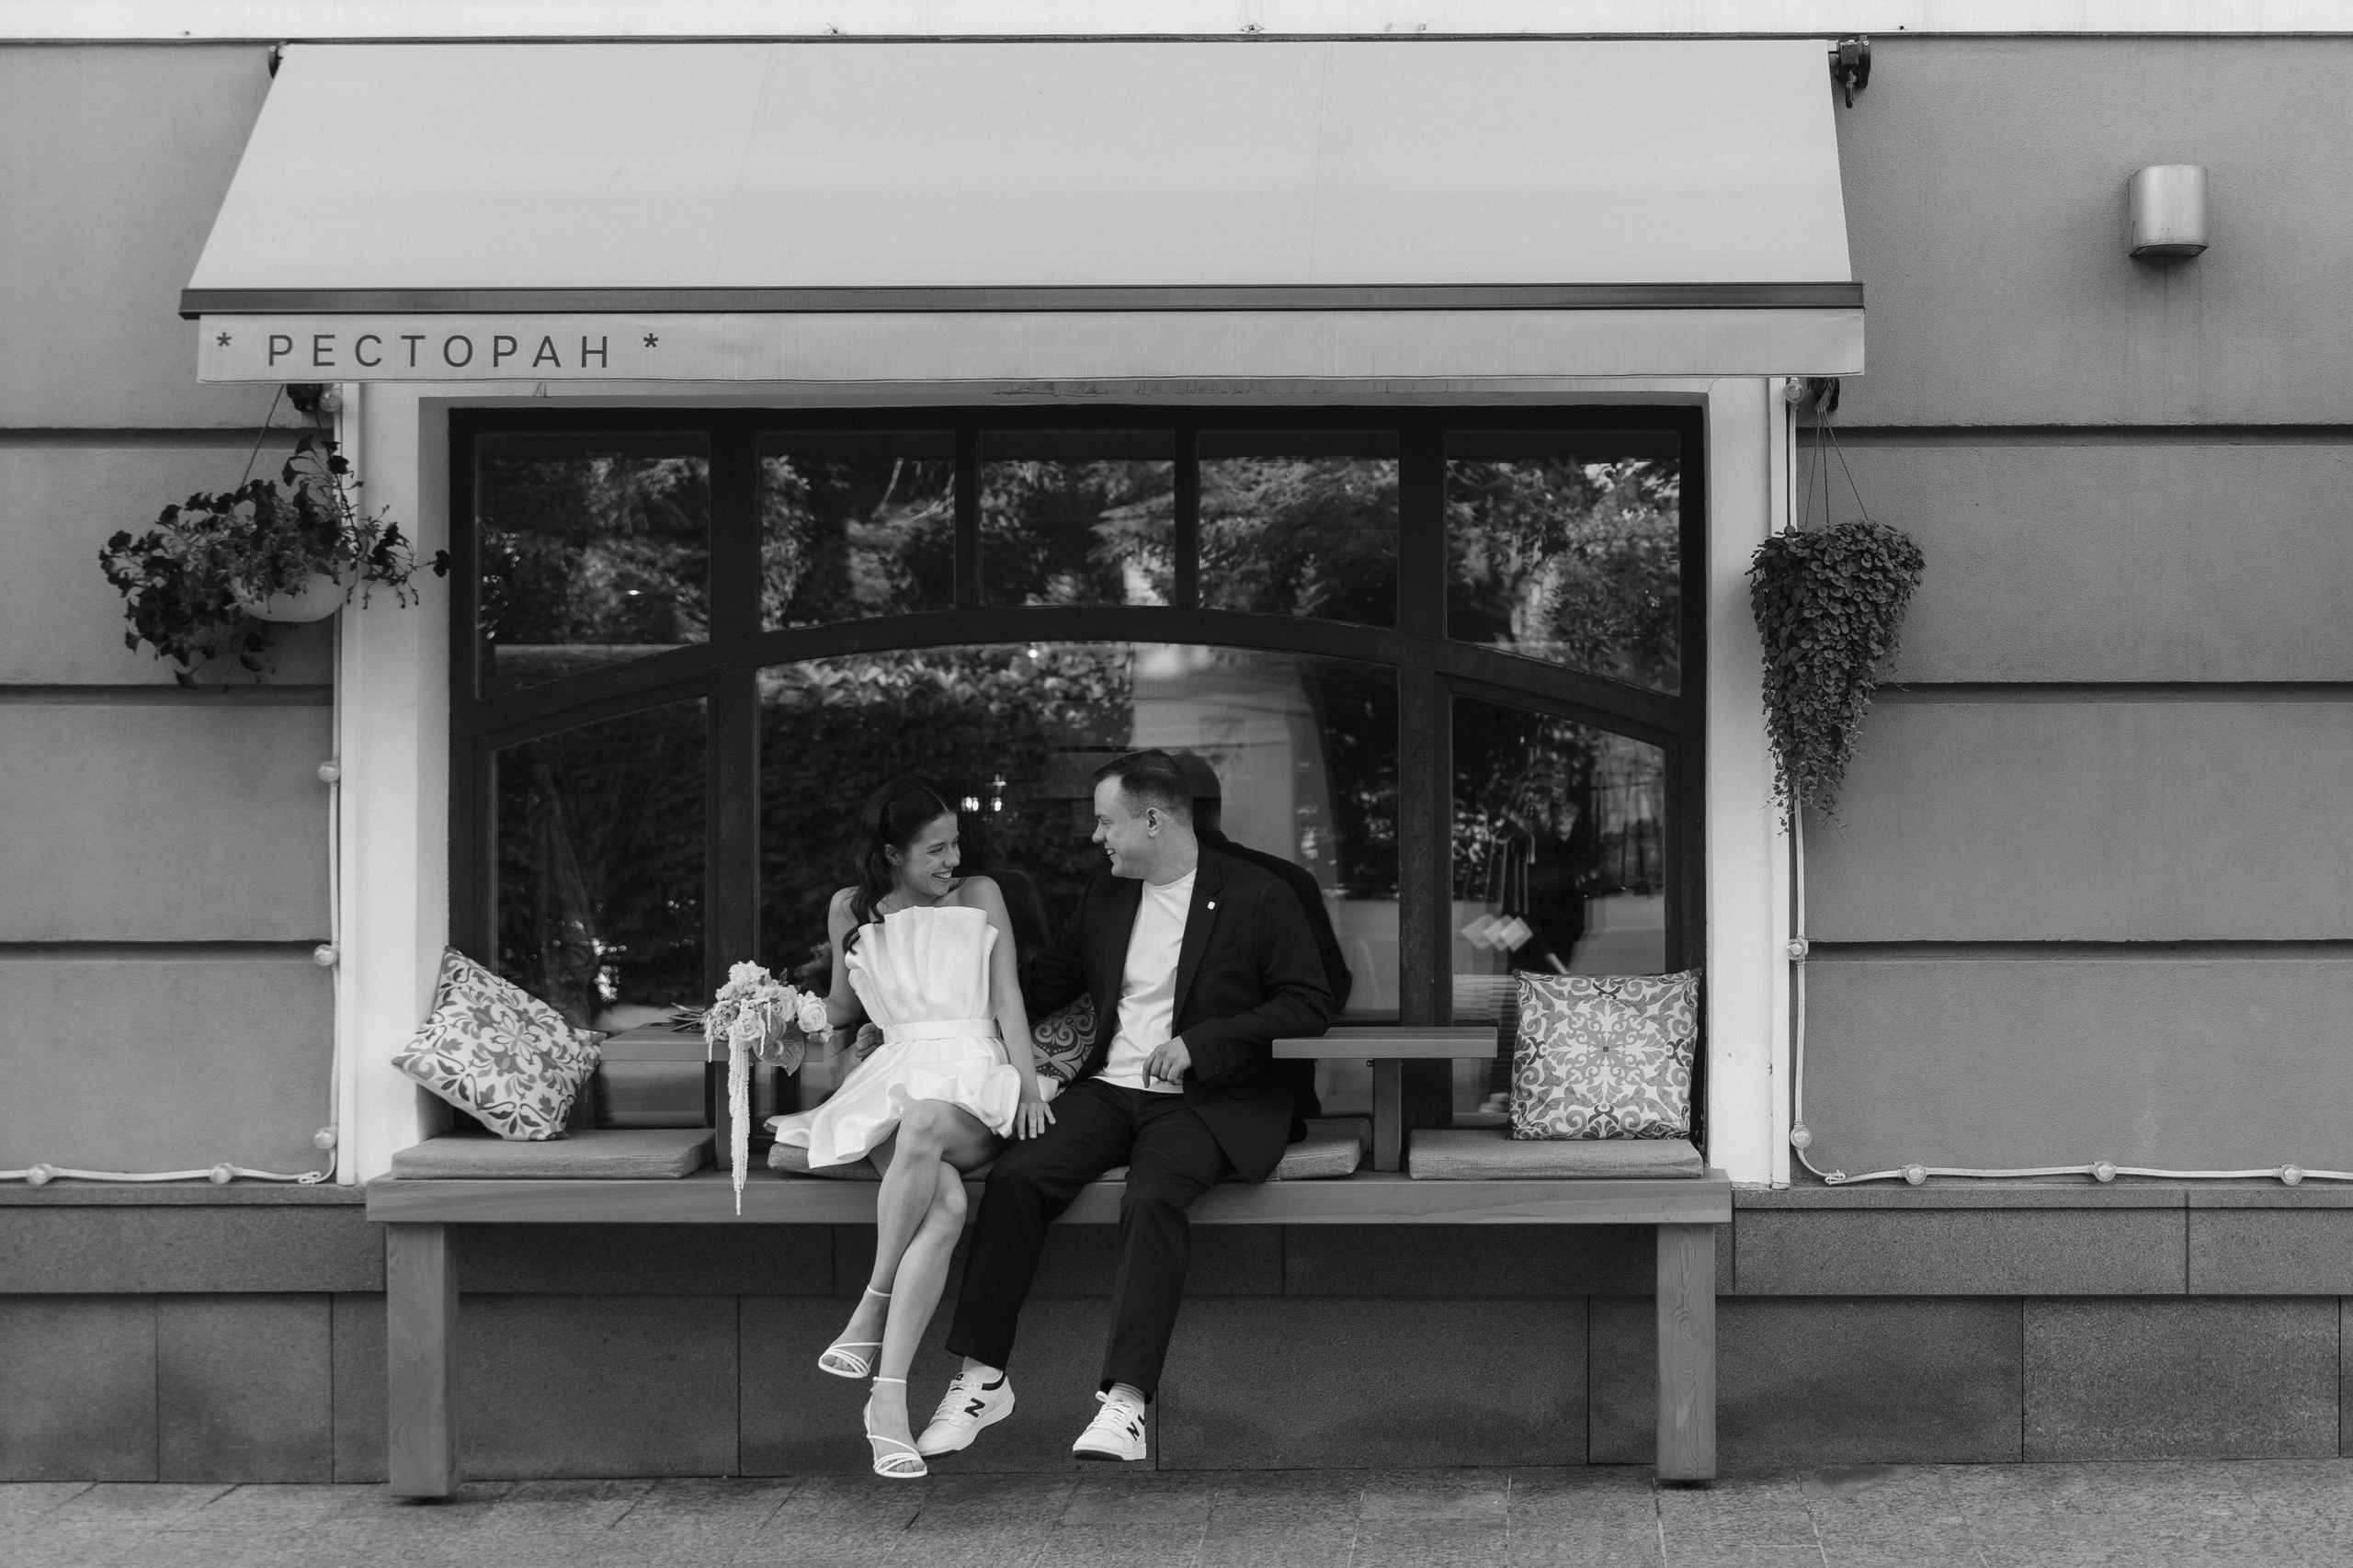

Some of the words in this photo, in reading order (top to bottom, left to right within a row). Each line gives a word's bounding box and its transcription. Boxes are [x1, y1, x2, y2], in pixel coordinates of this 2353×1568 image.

[268, 334, 608, 369] РЕСТОРАН
[964, 1397, 986, 1418] N
[1126, 1421, 1141, 1441] N
